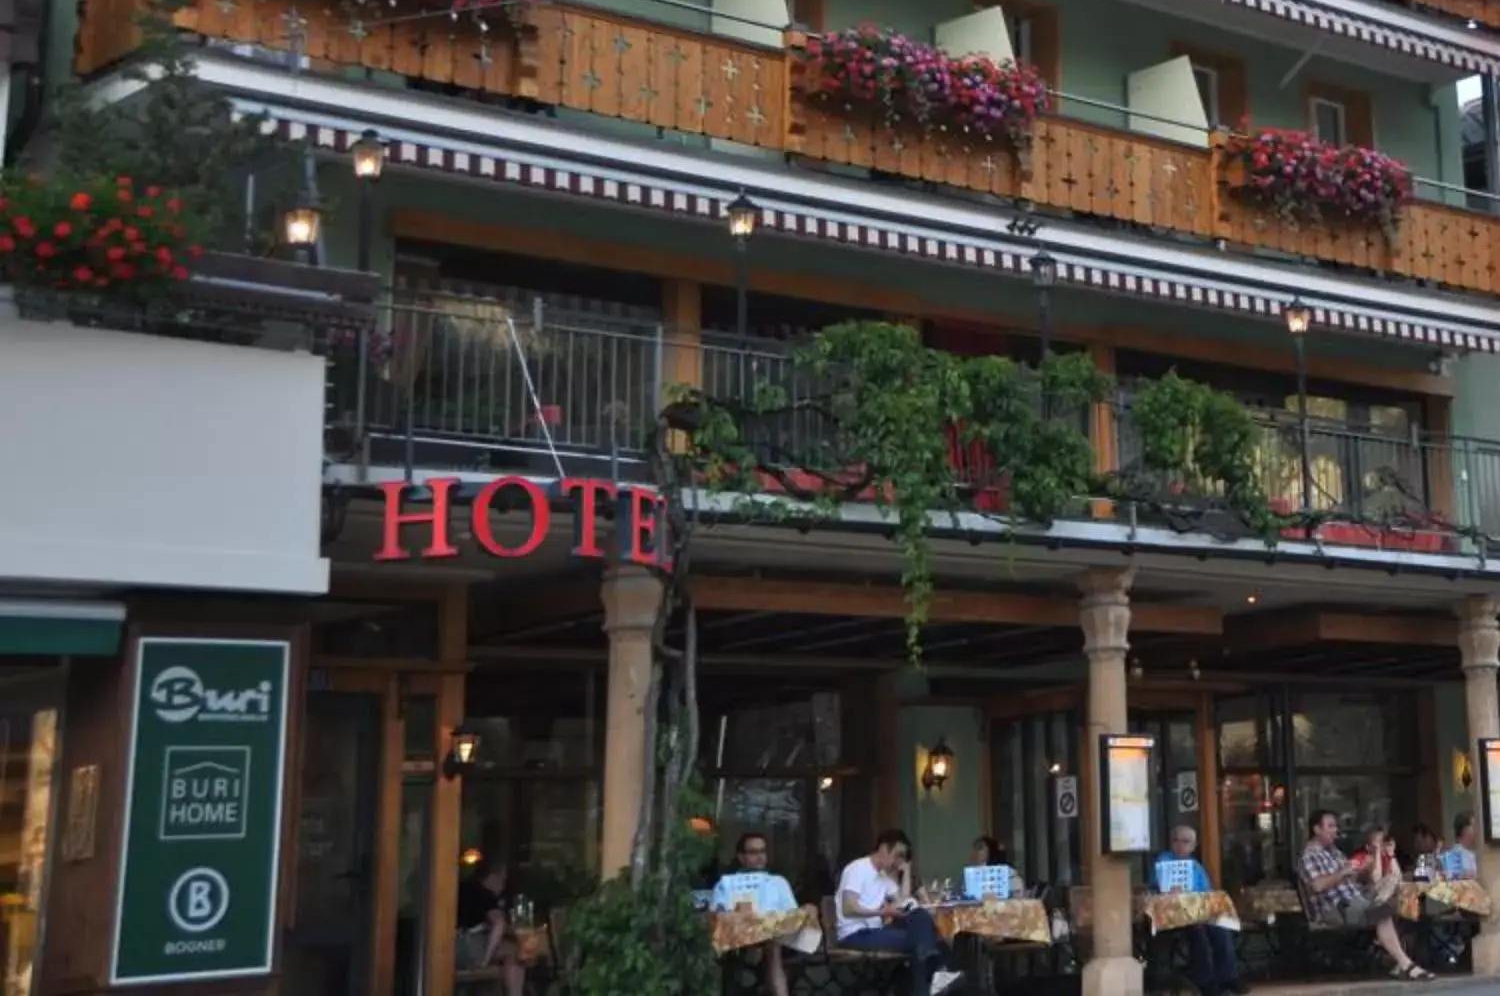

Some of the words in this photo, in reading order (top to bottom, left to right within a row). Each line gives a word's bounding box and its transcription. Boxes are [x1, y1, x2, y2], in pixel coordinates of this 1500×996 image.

[151, 667, 272, 718] Buri
[170, 777, 240, 799] BURI
[168, 801, 238, 823] HOME
